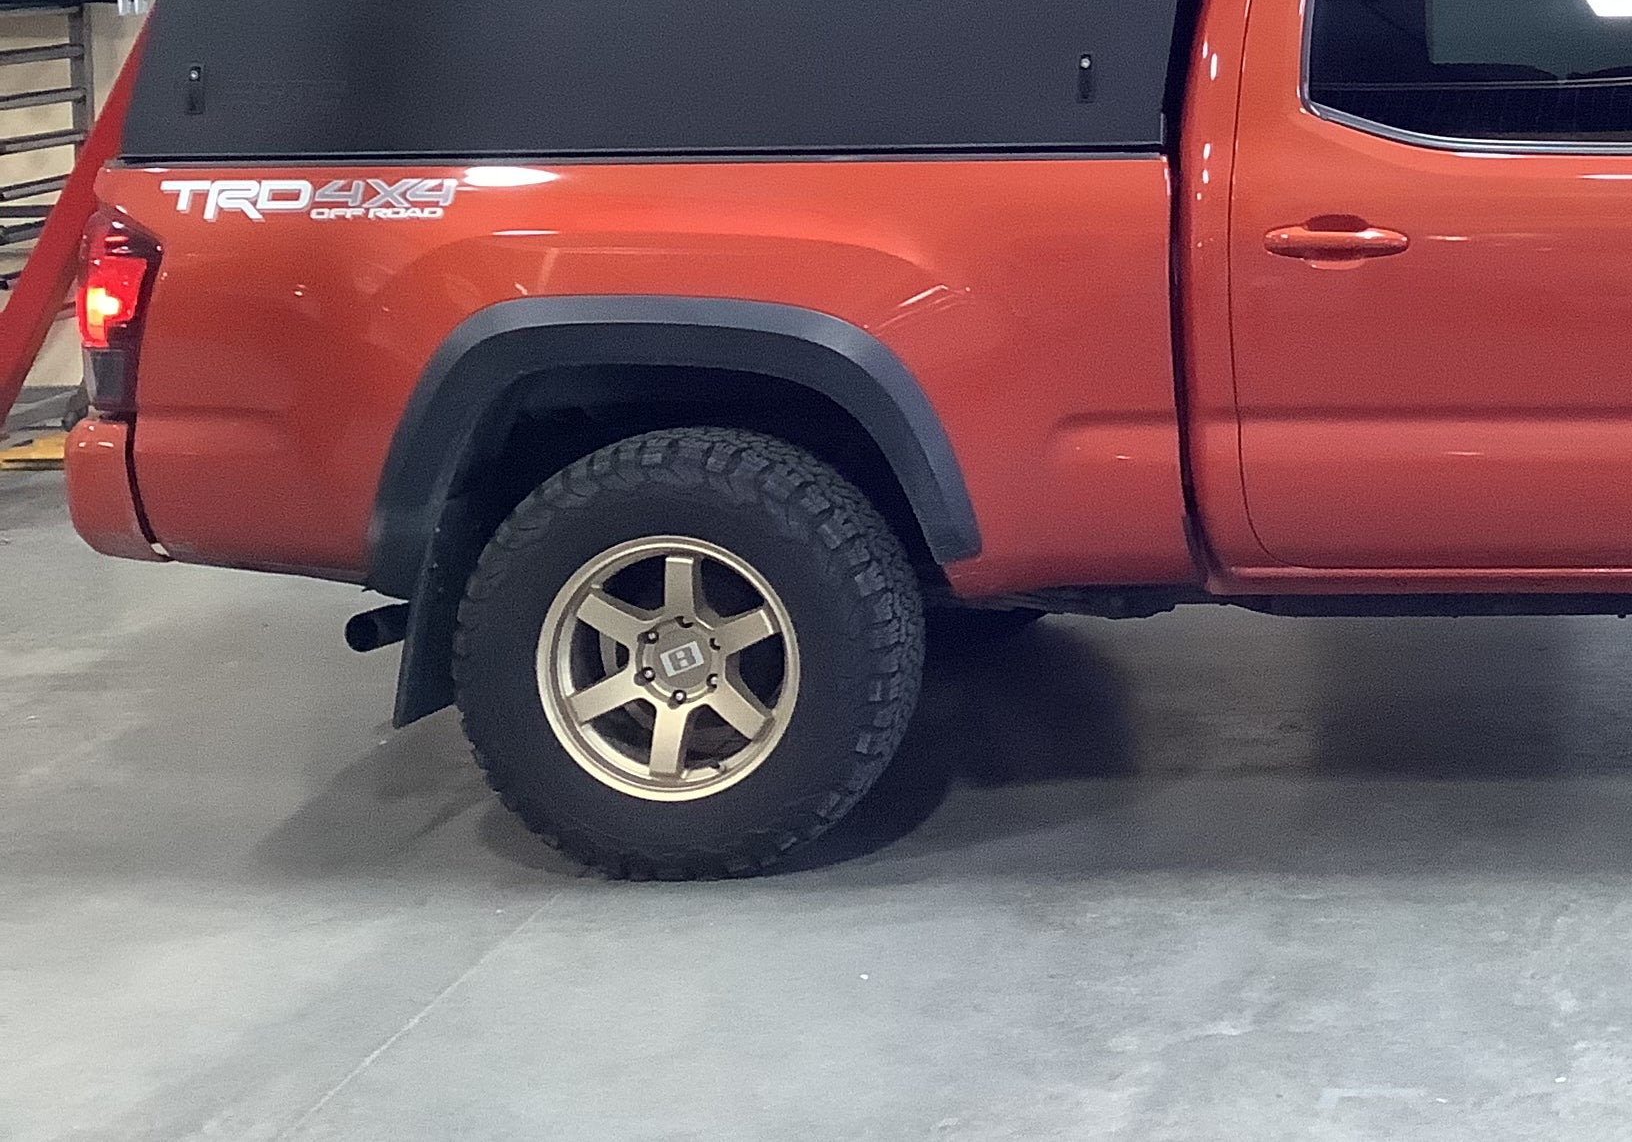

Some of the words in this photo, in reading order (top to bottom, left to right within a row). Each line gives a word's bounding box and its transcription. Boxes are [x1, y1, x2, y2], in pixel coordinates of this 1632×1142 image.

[160, 179, 315, 222] TRD
[309, 207, 365, 220] OFF
[367, 206, 444, 220] ROAD
